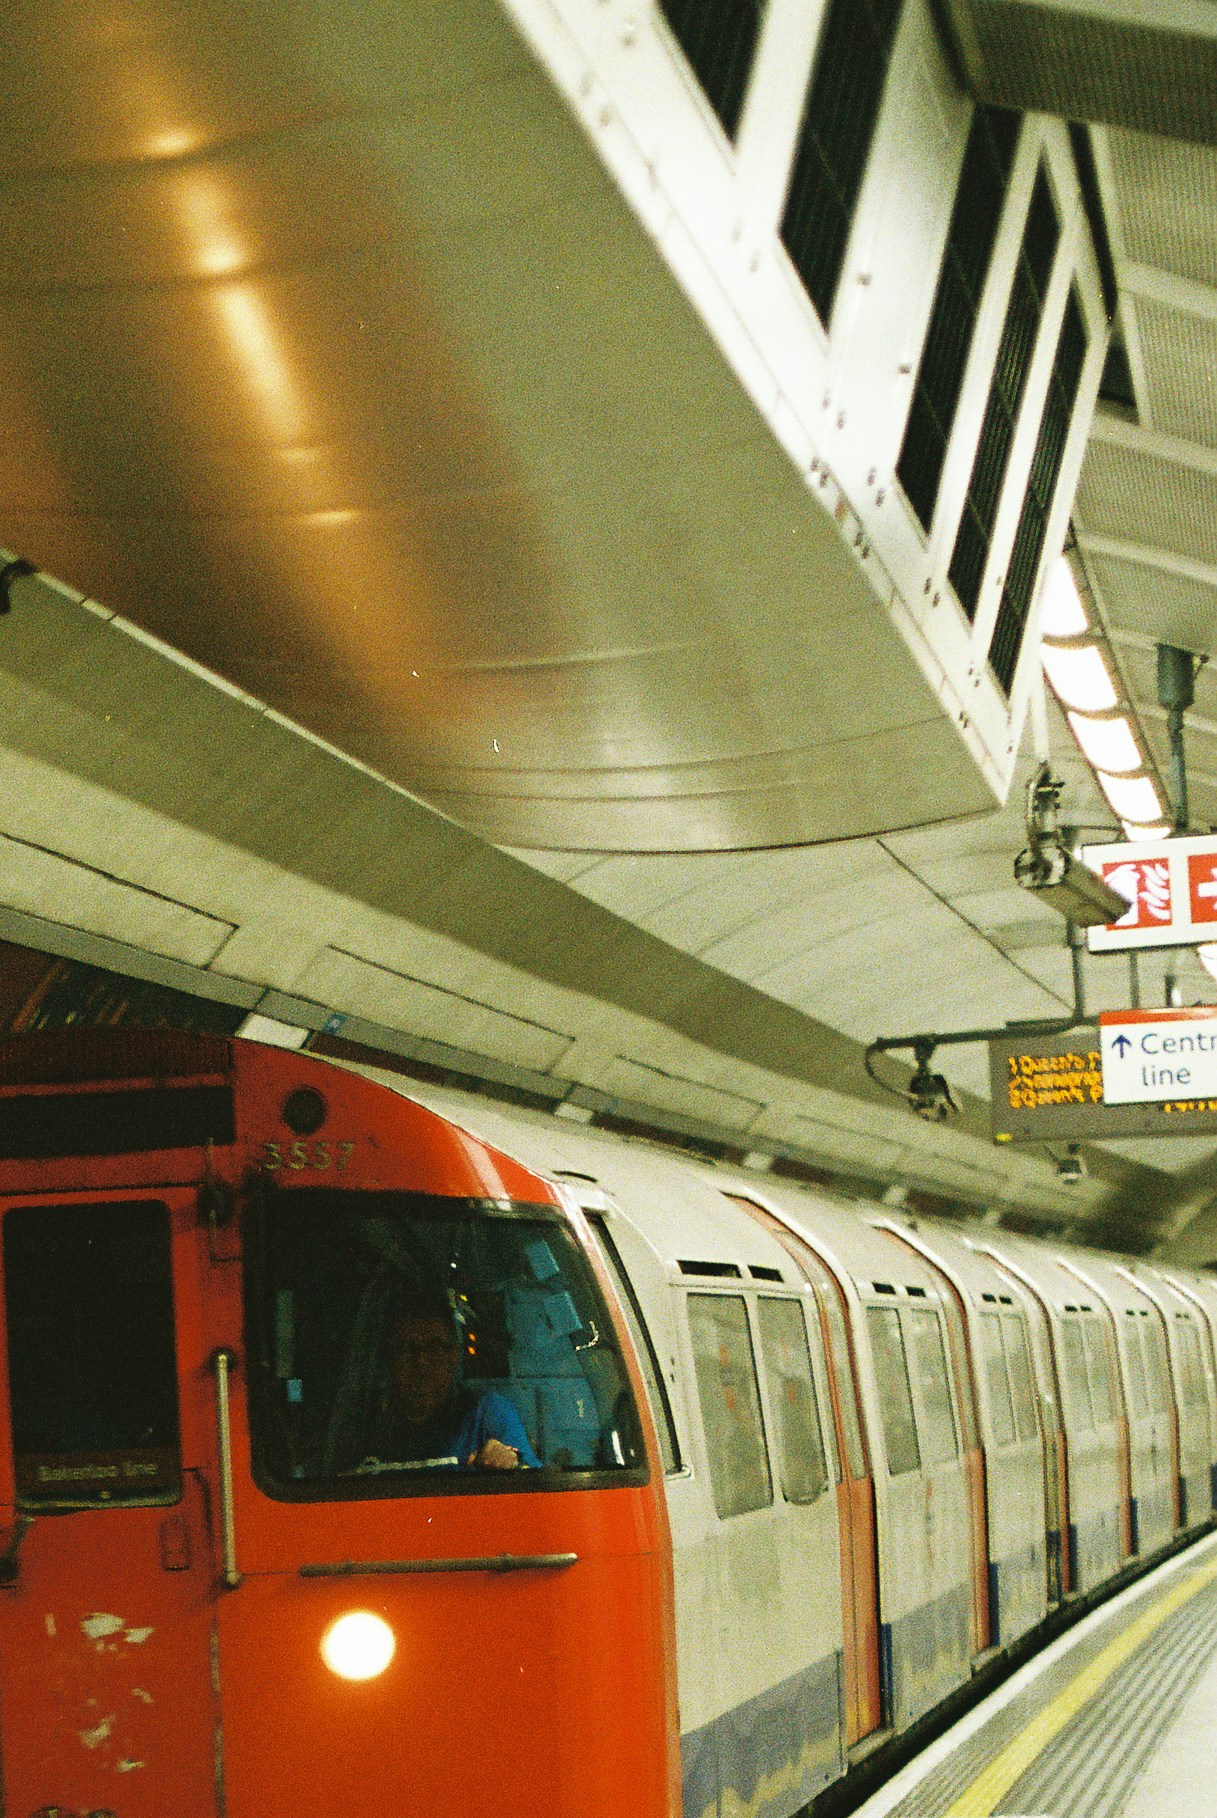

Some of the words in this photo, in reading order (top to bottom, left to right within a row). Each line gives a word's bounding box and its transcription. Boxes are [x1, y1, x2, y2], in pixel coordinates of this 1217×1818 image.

[1019, 1052, 1086, 1076] Queen's
[1142, 1065, 1192, 1088] line
[263, 1140, 356, 1171] 3557
[38, 1463, 119, 1483] Bakerloo
[122, 1459, 160, 1478] line
